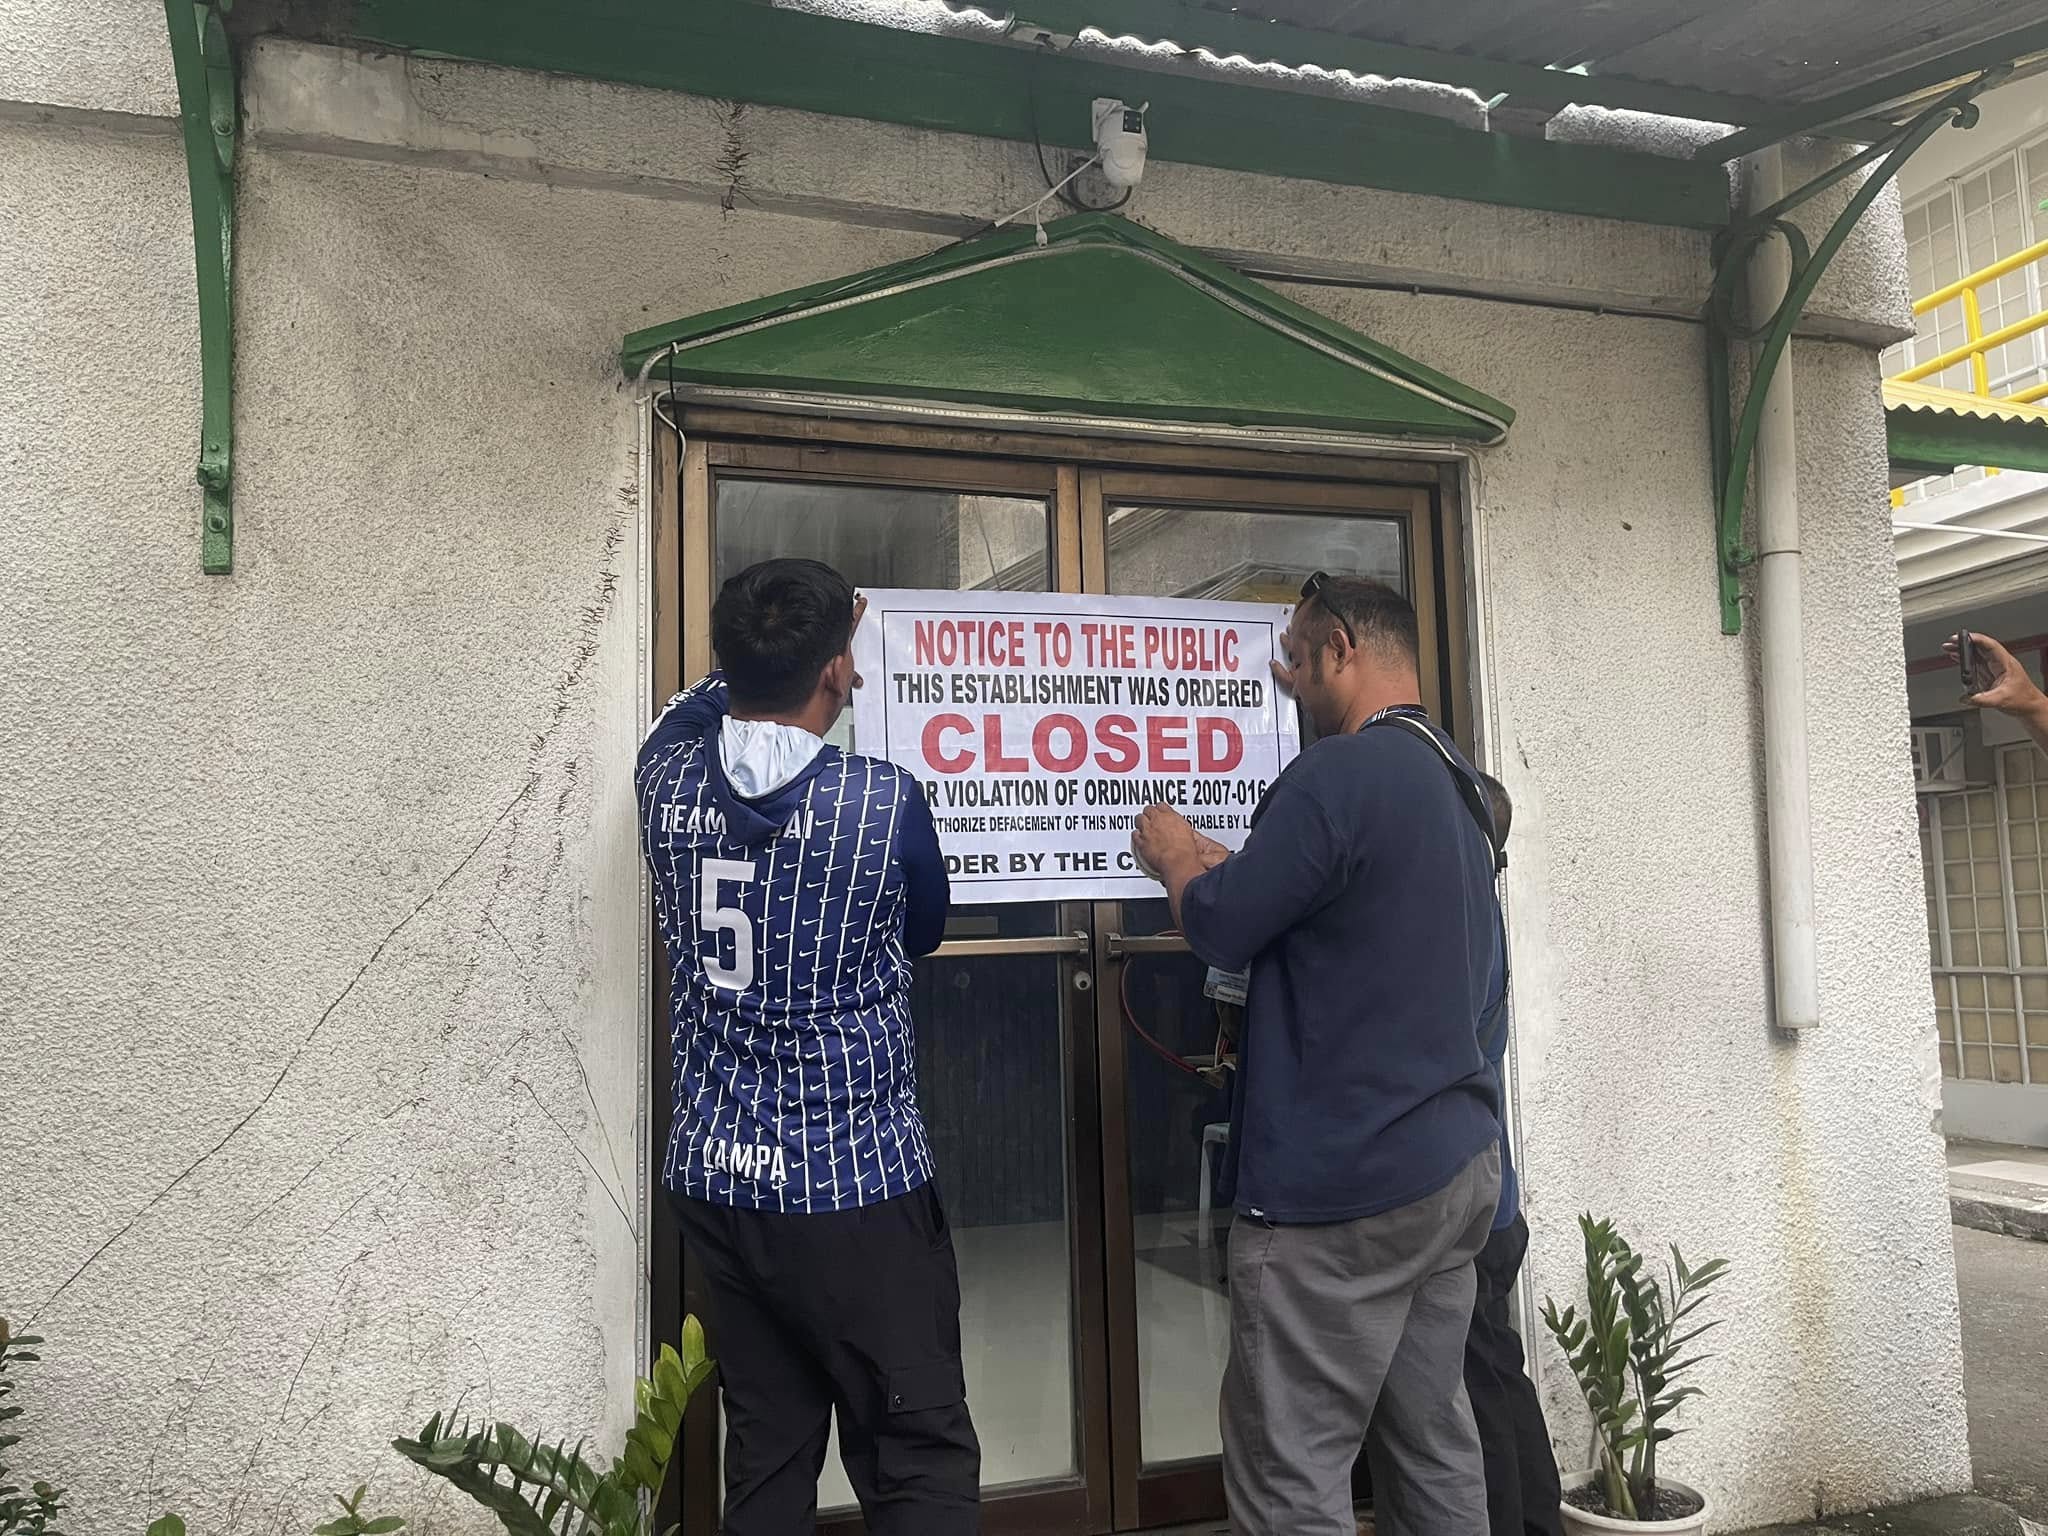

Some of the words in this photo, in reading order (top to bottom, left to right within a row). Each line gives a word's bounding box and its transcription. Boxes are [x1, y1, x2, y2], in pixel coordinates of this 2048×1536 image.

[915, 620, 1025, 667] NOTICE
[1034, 622, 1072, 667] TO
[1081, 624, 1136, 668] THE
[1144, 626, 1239, 672] PUBLIC
[893, 673, 944, 704] THIS
[951, 674, 1122, 705] ESTABLISHMENT
[1128, 676, 1169, 706] WAS
[1175, 678, 1263, 708] ORDERED
[921, 713, 1243, 773] CLOSED
[944, 779, 1048, 808] VIOLATION
[1055, 779, 1078, 806] OF
[1084, 779, 1187, 805] ORDINANCE
[660, 803, 727, 835] TEAM
[933, 816, 986, 832] THORIZE
[990, 815, 1061, 832] DEFACEMENT
[1065, 815, 1079, 831] OF
[1082, 815, 1106, 831] THIS
[1110, 815, 1135, 830] NOTI
[1184, 814, 1225, 829] SHABLE
[1228, 814, 1240, 829] BY
[944, 855, 999, 874] DER
[1009, 853, 1045, 872] BY
[1054, 852, 1108, 871] THE
[701, 857, 757, 991] 5
[703, 1136, 787, 1181] LAMPA
